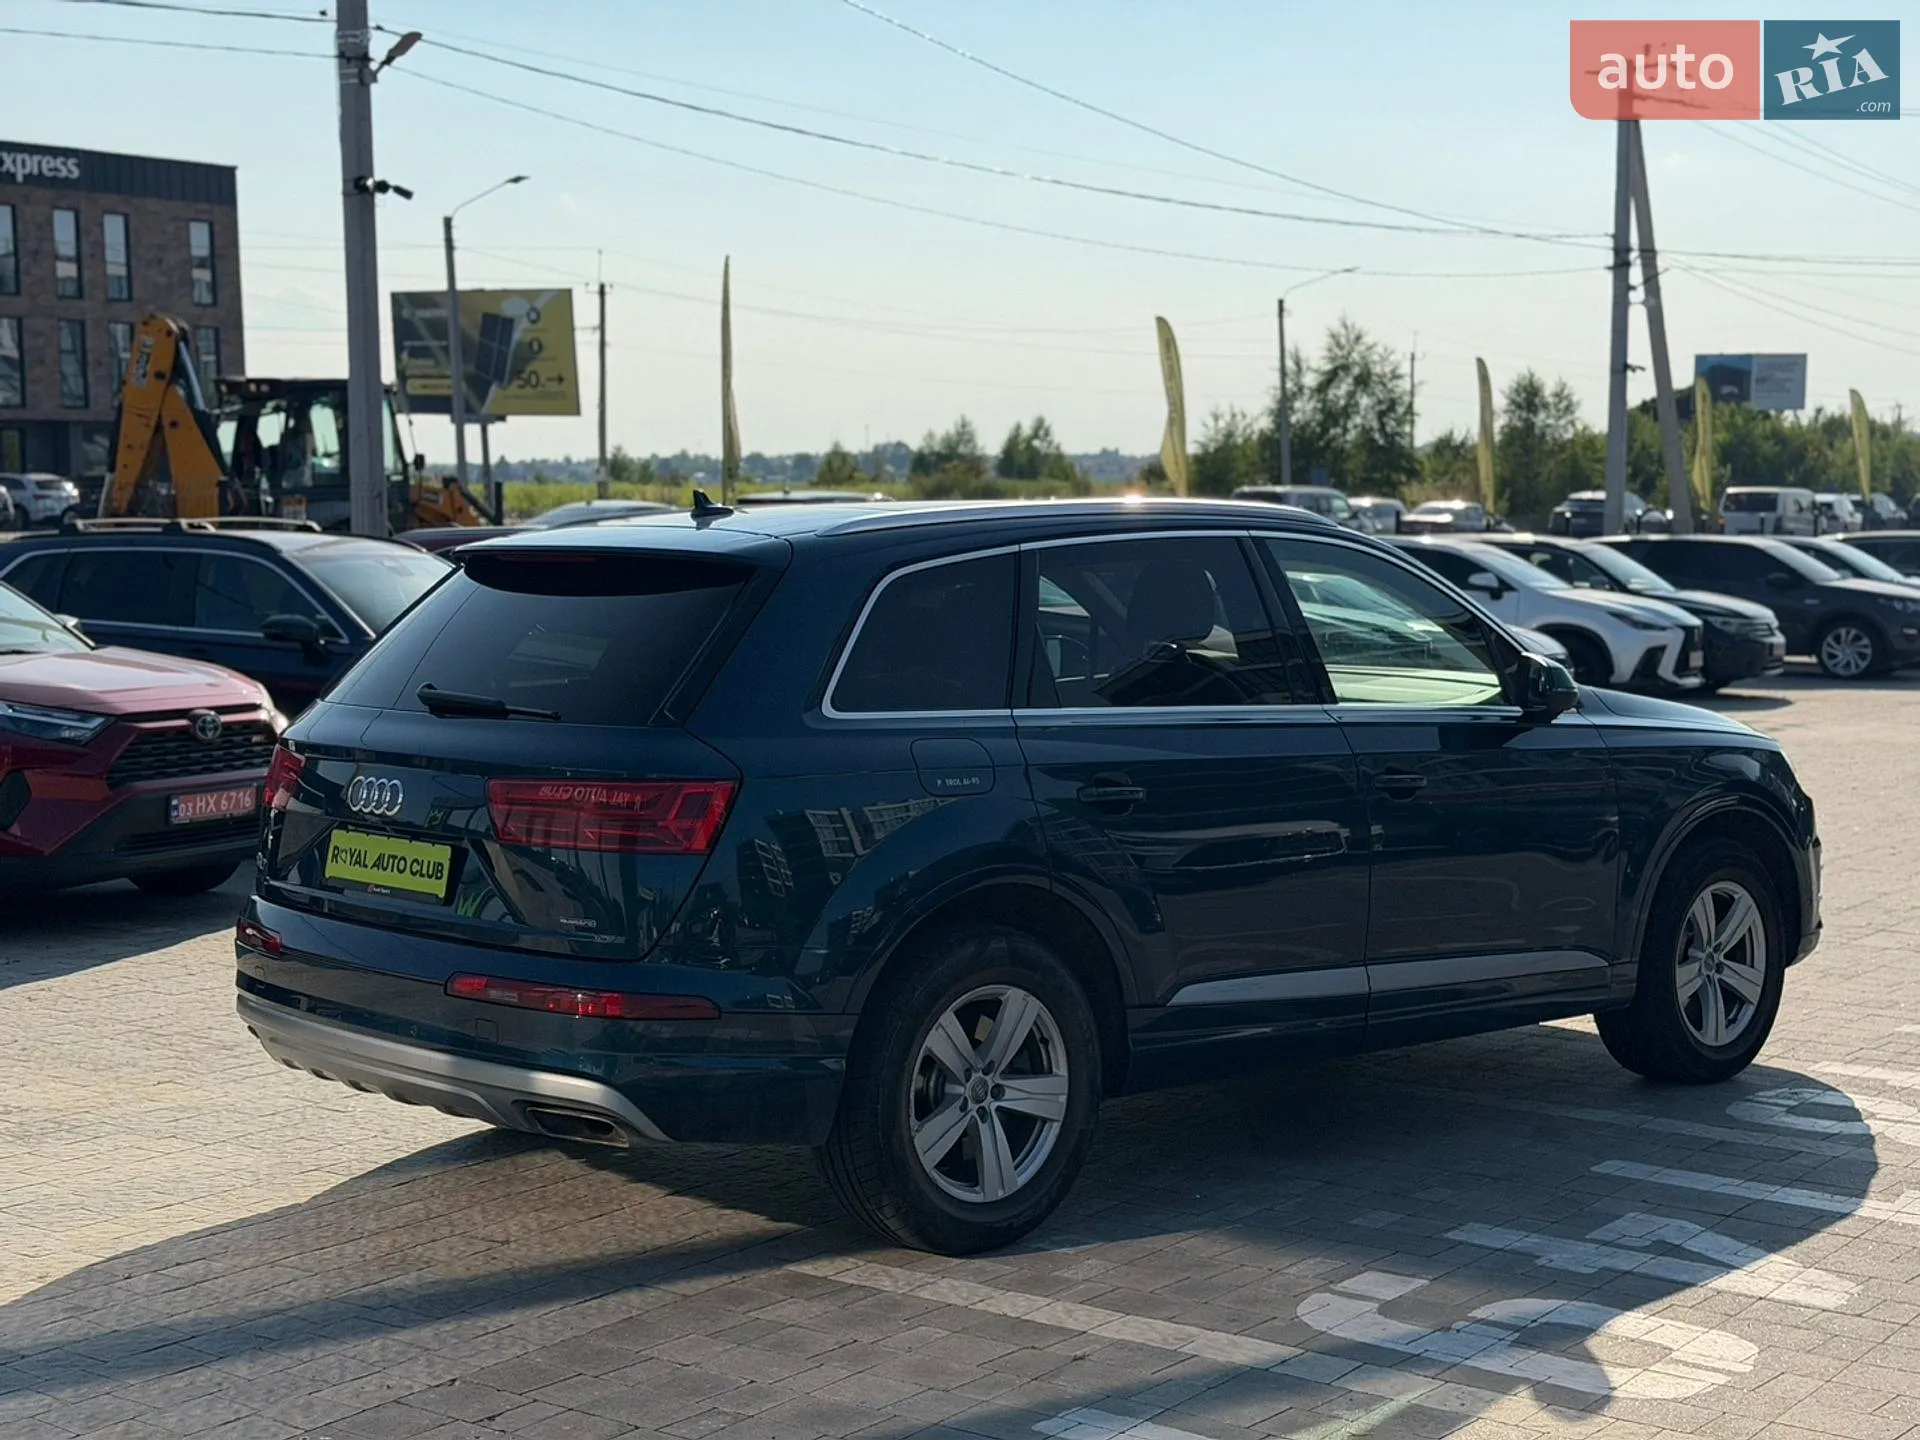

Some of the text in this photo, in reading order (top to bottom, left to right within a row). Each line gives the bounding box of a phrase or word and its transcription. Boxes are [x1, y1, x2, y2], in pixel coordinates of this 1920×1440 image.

[0, 151, 80, 184] xpress
[196, 793, 217, 815] HX
[220, 789, 252, 811] 6716
[370, 852, 408, 874] AUTO
[409, 858, 445, 881] CLUB
